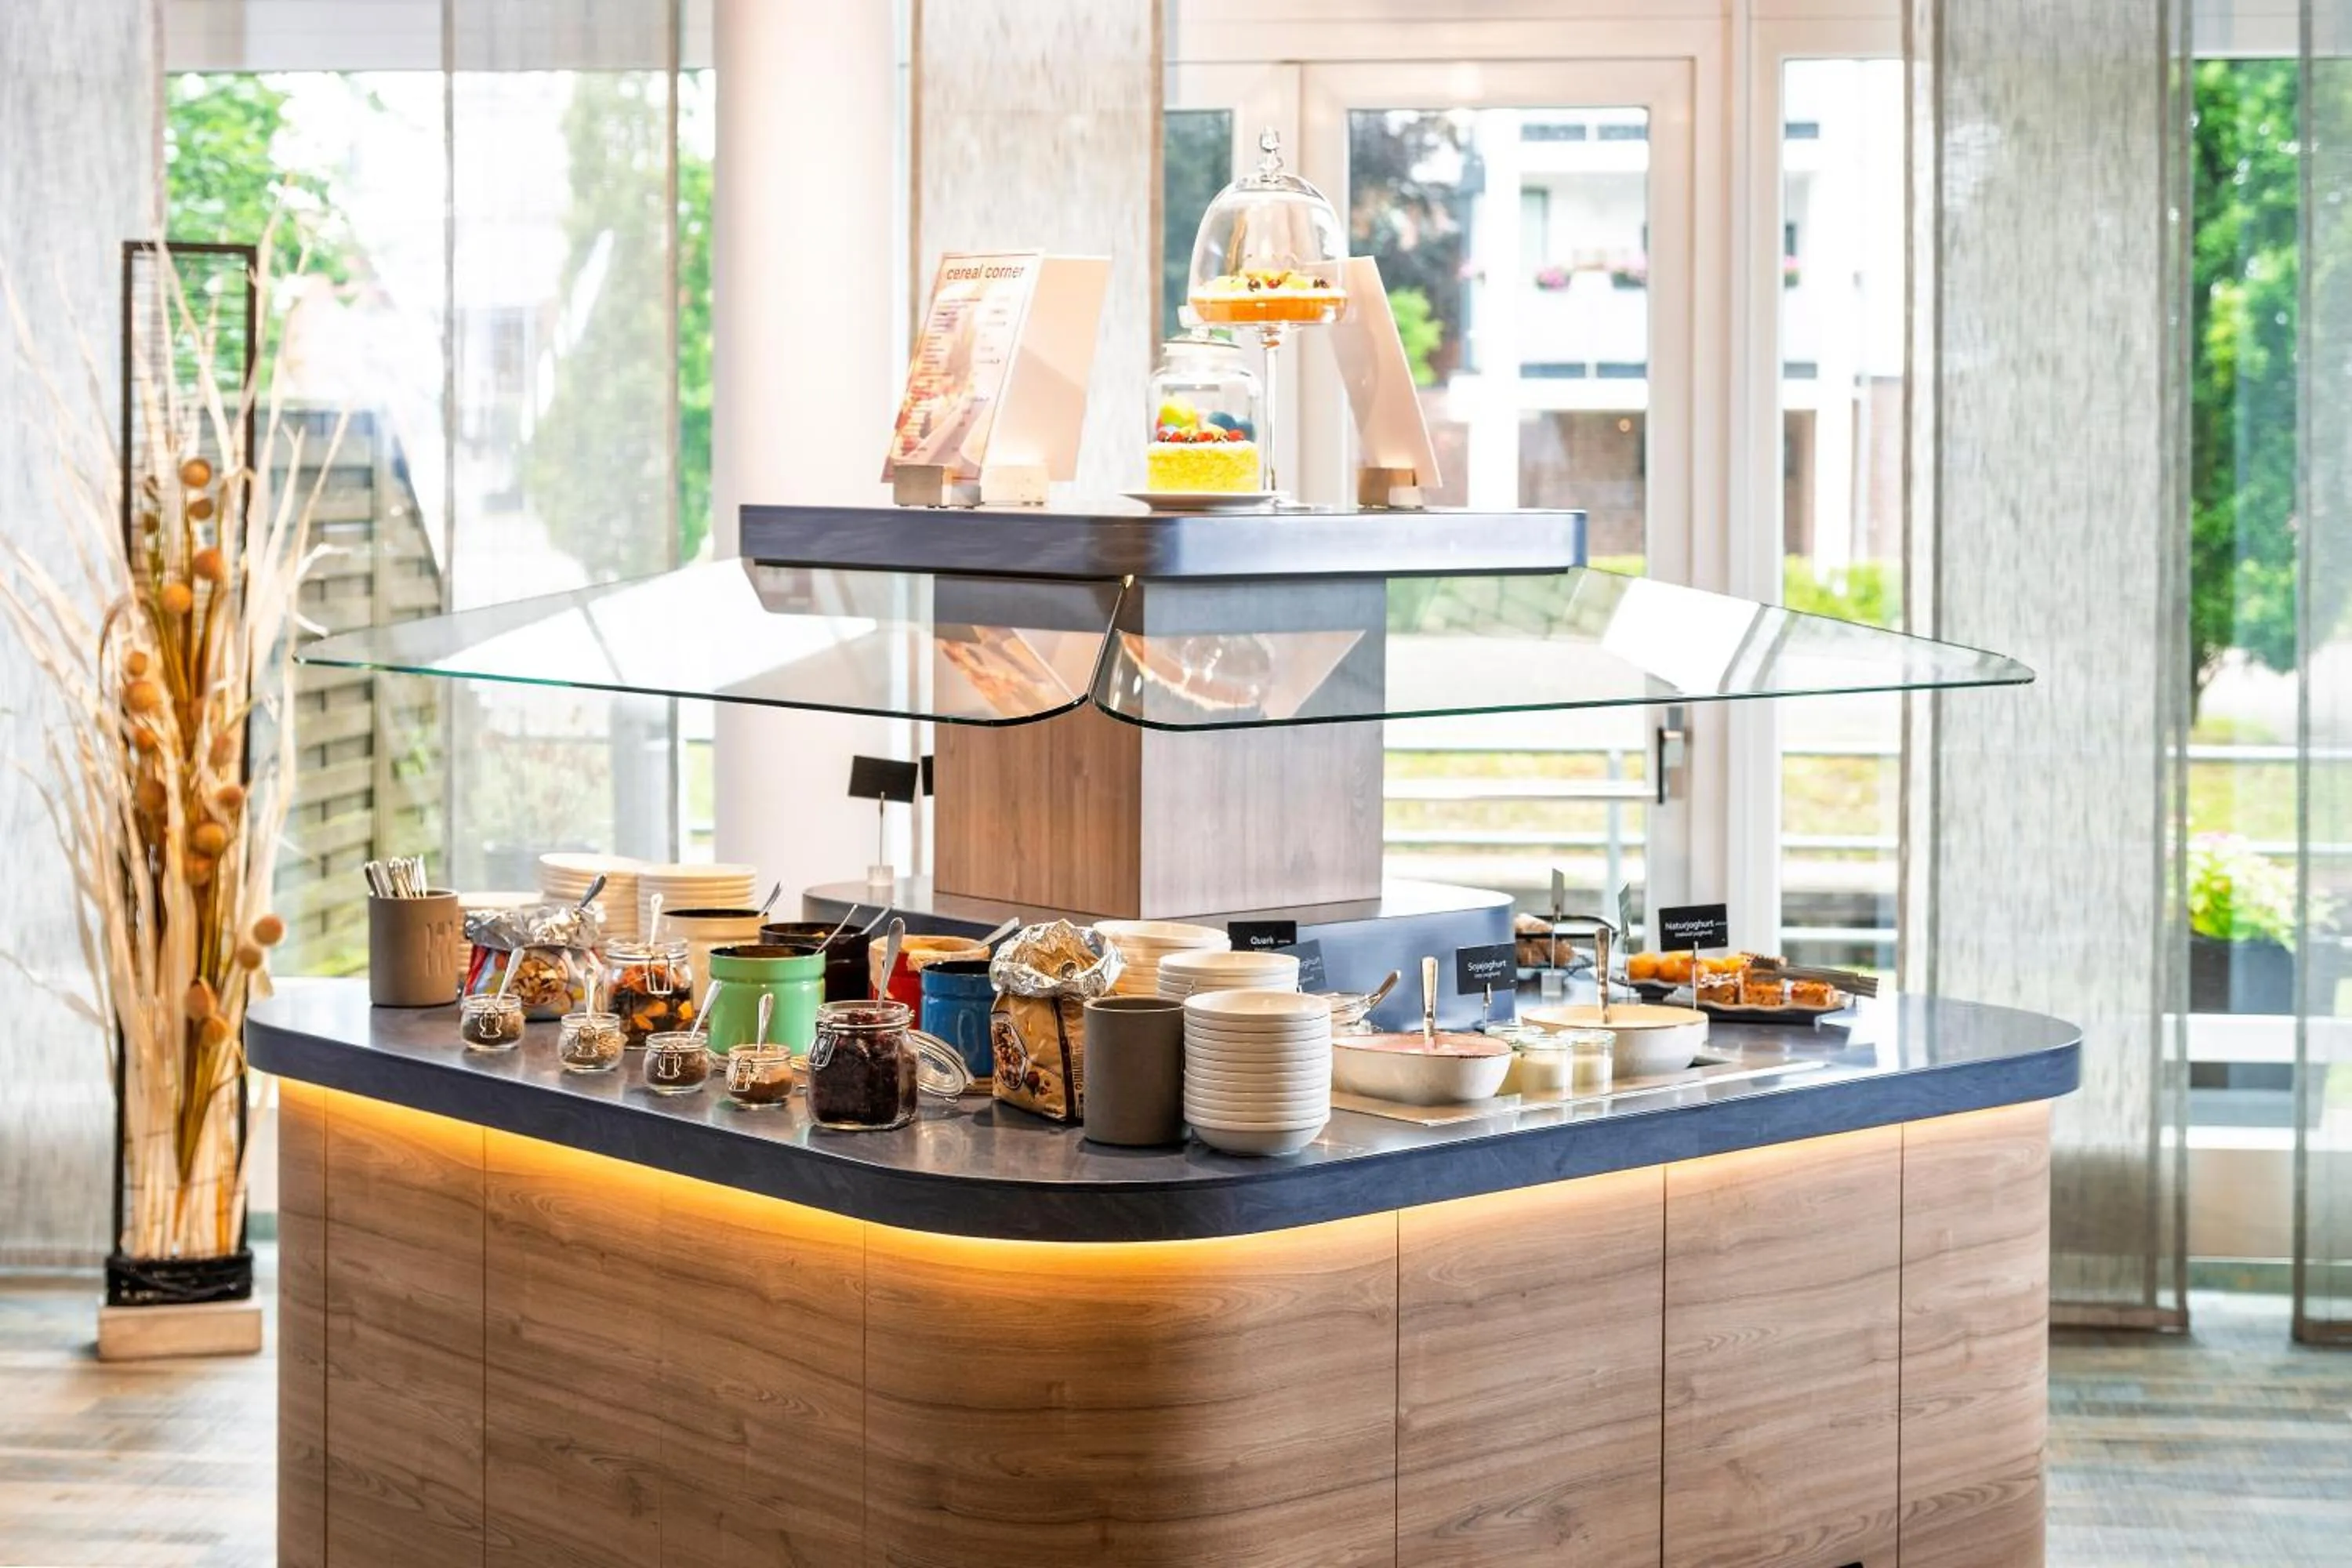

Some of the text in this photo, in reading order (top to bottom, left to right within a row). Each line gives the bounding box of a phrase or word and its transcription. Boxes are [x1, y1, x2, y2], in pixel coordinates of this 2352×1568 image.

[946, 263, 1025, 280] cereal corner
[1250, 935, 1274, 945] Quark
